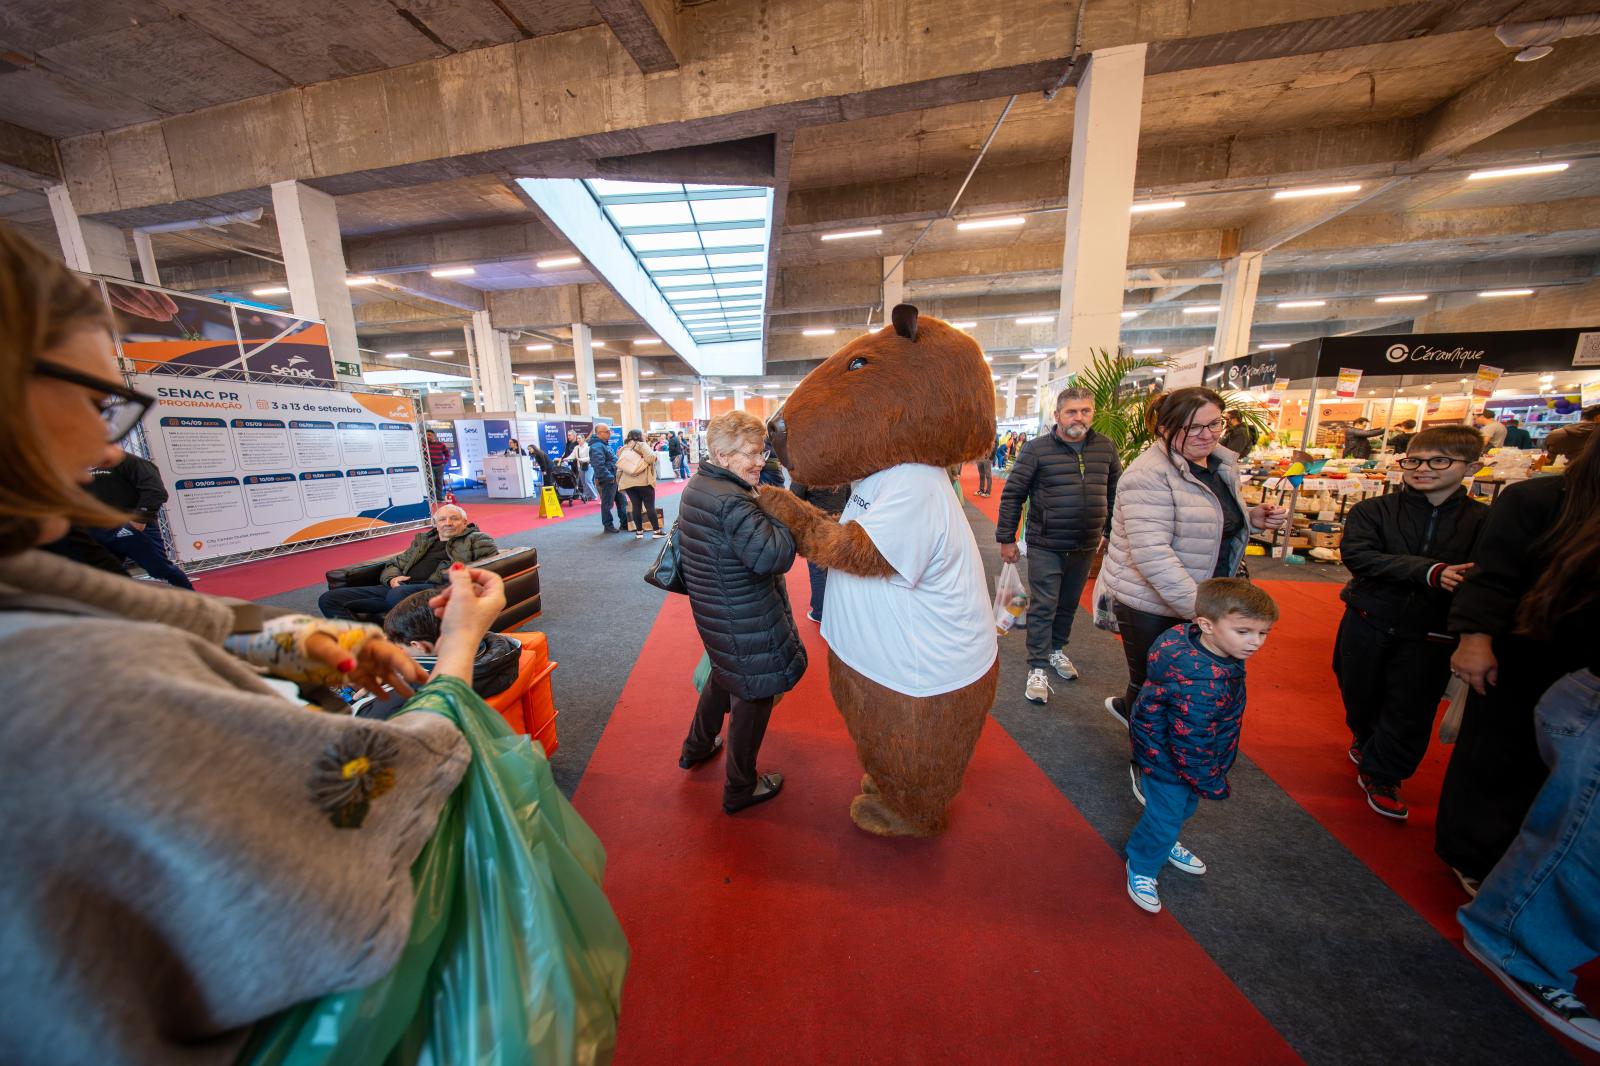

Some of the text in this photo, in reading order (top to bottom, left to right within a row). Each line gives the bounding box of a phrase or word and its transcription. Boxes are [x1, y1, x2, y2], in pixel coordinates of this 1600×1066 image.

[270, 364, 315, 379] Senac
[157, 387, 239, 401] SENAC PR
[159, 399, 242, 411] PROGRAMAÇÃO
[272, 401, 279, 410] 3
[289, 402, 301, 411] 13
[302, 403, 316, 412] de
[318, 405, 362, 414] setembro
